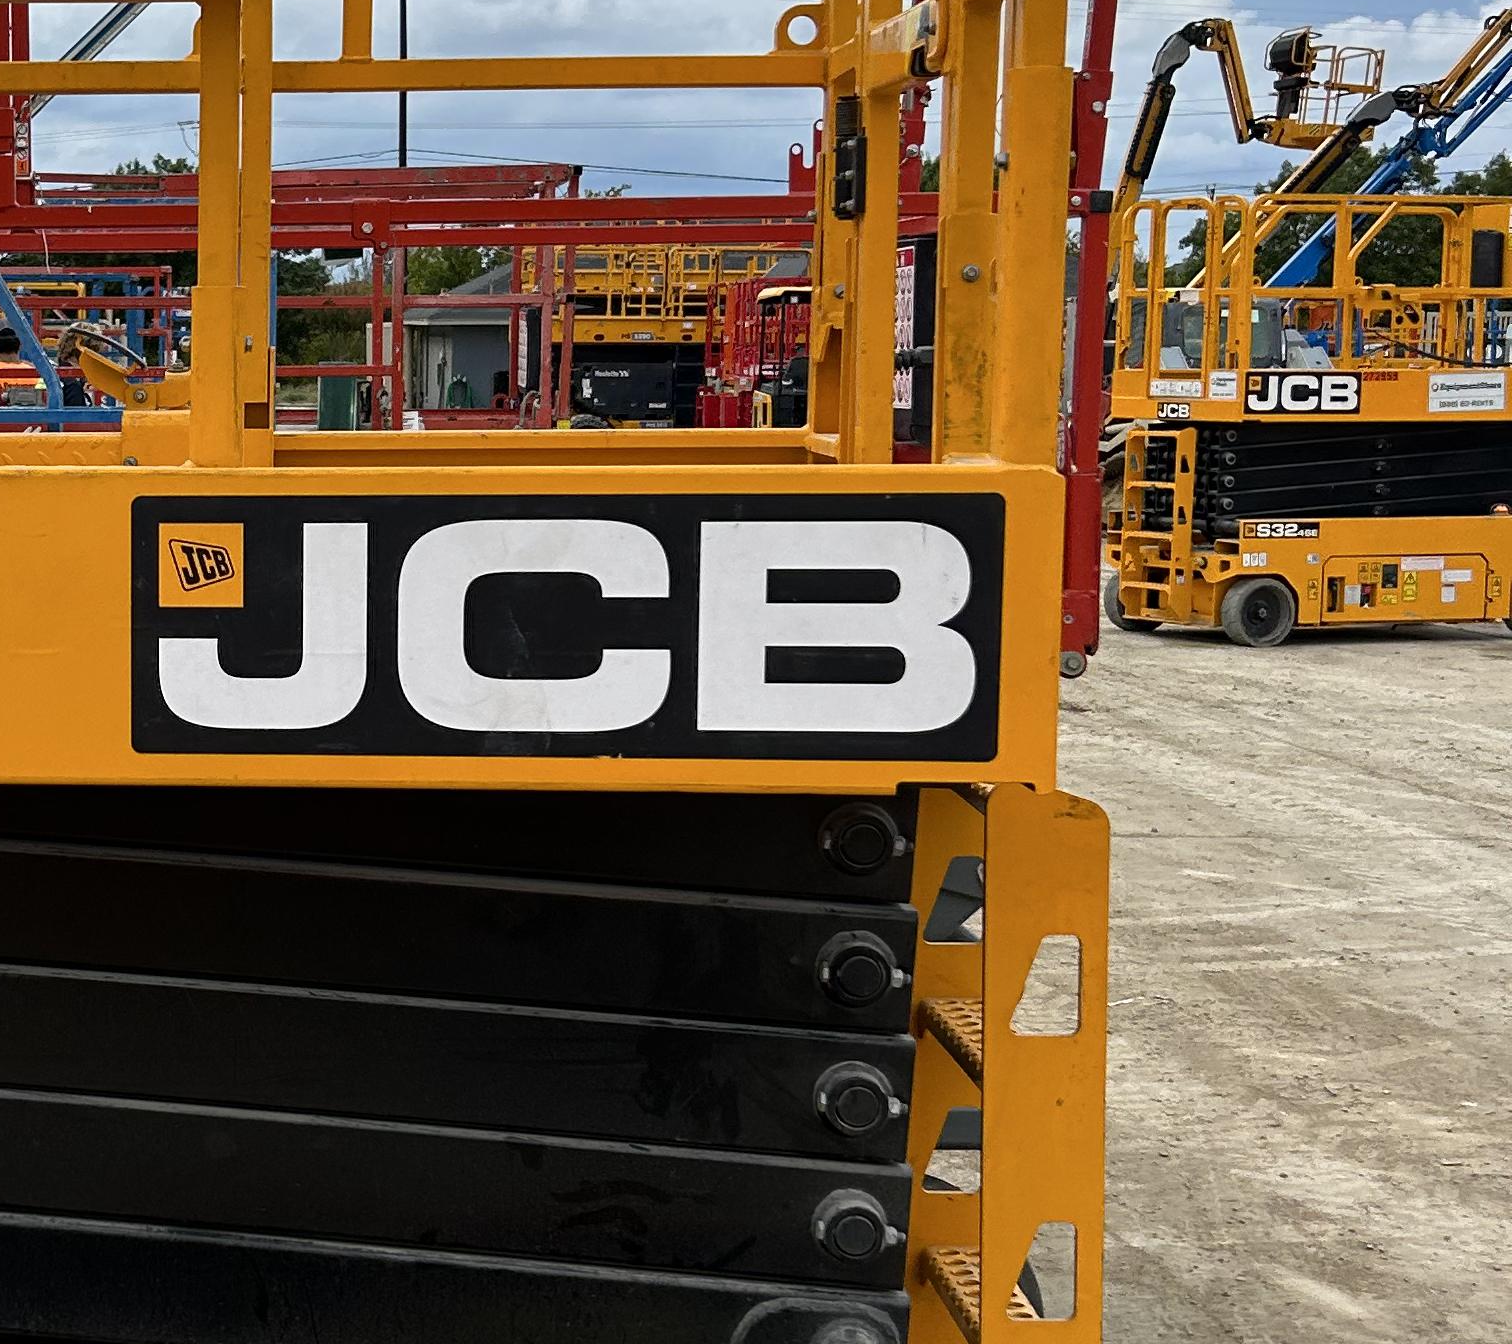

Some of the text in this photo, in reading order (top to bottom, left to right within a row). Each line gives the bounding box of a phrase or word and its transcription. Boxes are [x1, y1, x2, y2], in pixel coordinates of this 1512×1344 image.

[1158, 404, 1189, 418] JCB
[1248, 375, 1358, 411] JCB
[180, 542, 232, 586] JCB
[158, 518, 976, 733] JCB
